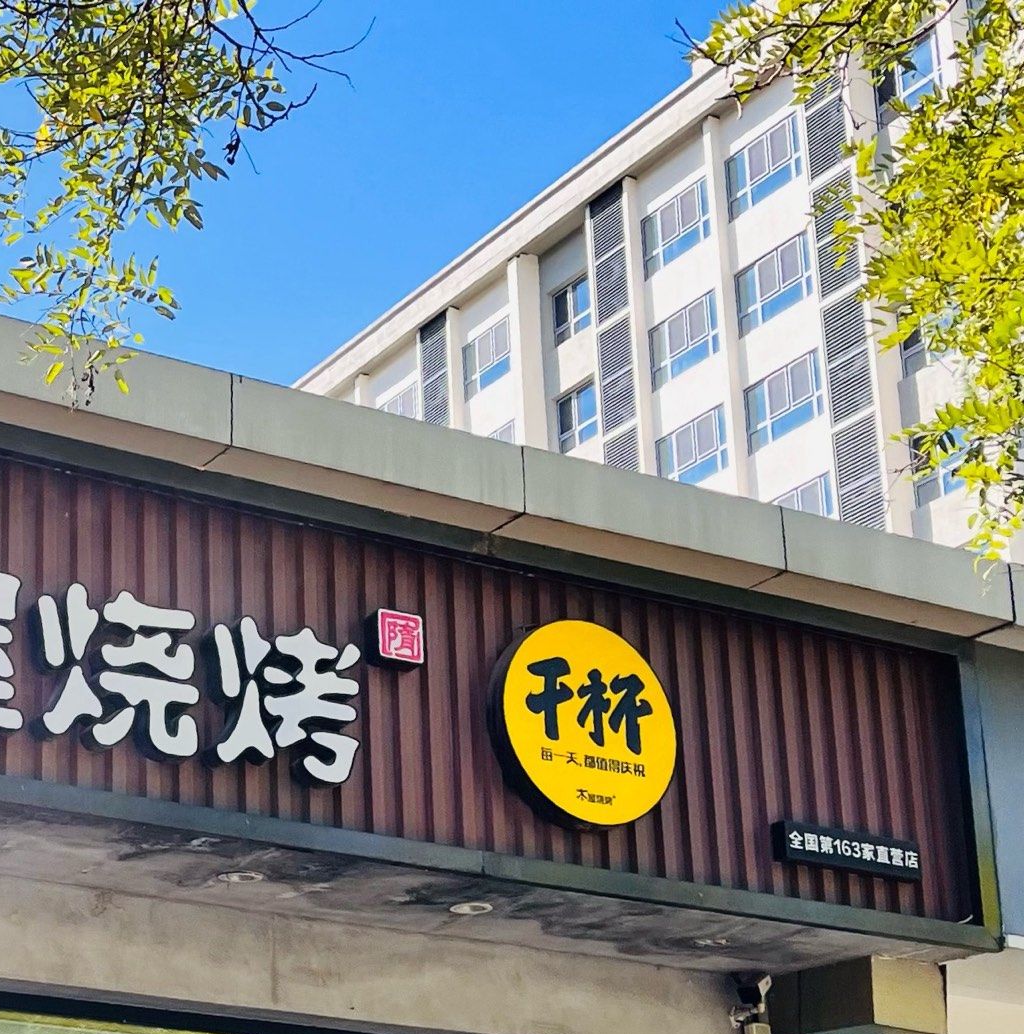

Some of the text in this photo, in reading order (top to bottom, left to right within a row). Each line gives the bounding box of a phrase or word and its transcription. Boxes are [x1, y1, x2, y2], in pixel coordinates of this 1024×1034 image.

[525, 657, 653, 755] 干杯
[788, 830, 919, 869] 全国第163家直营店
